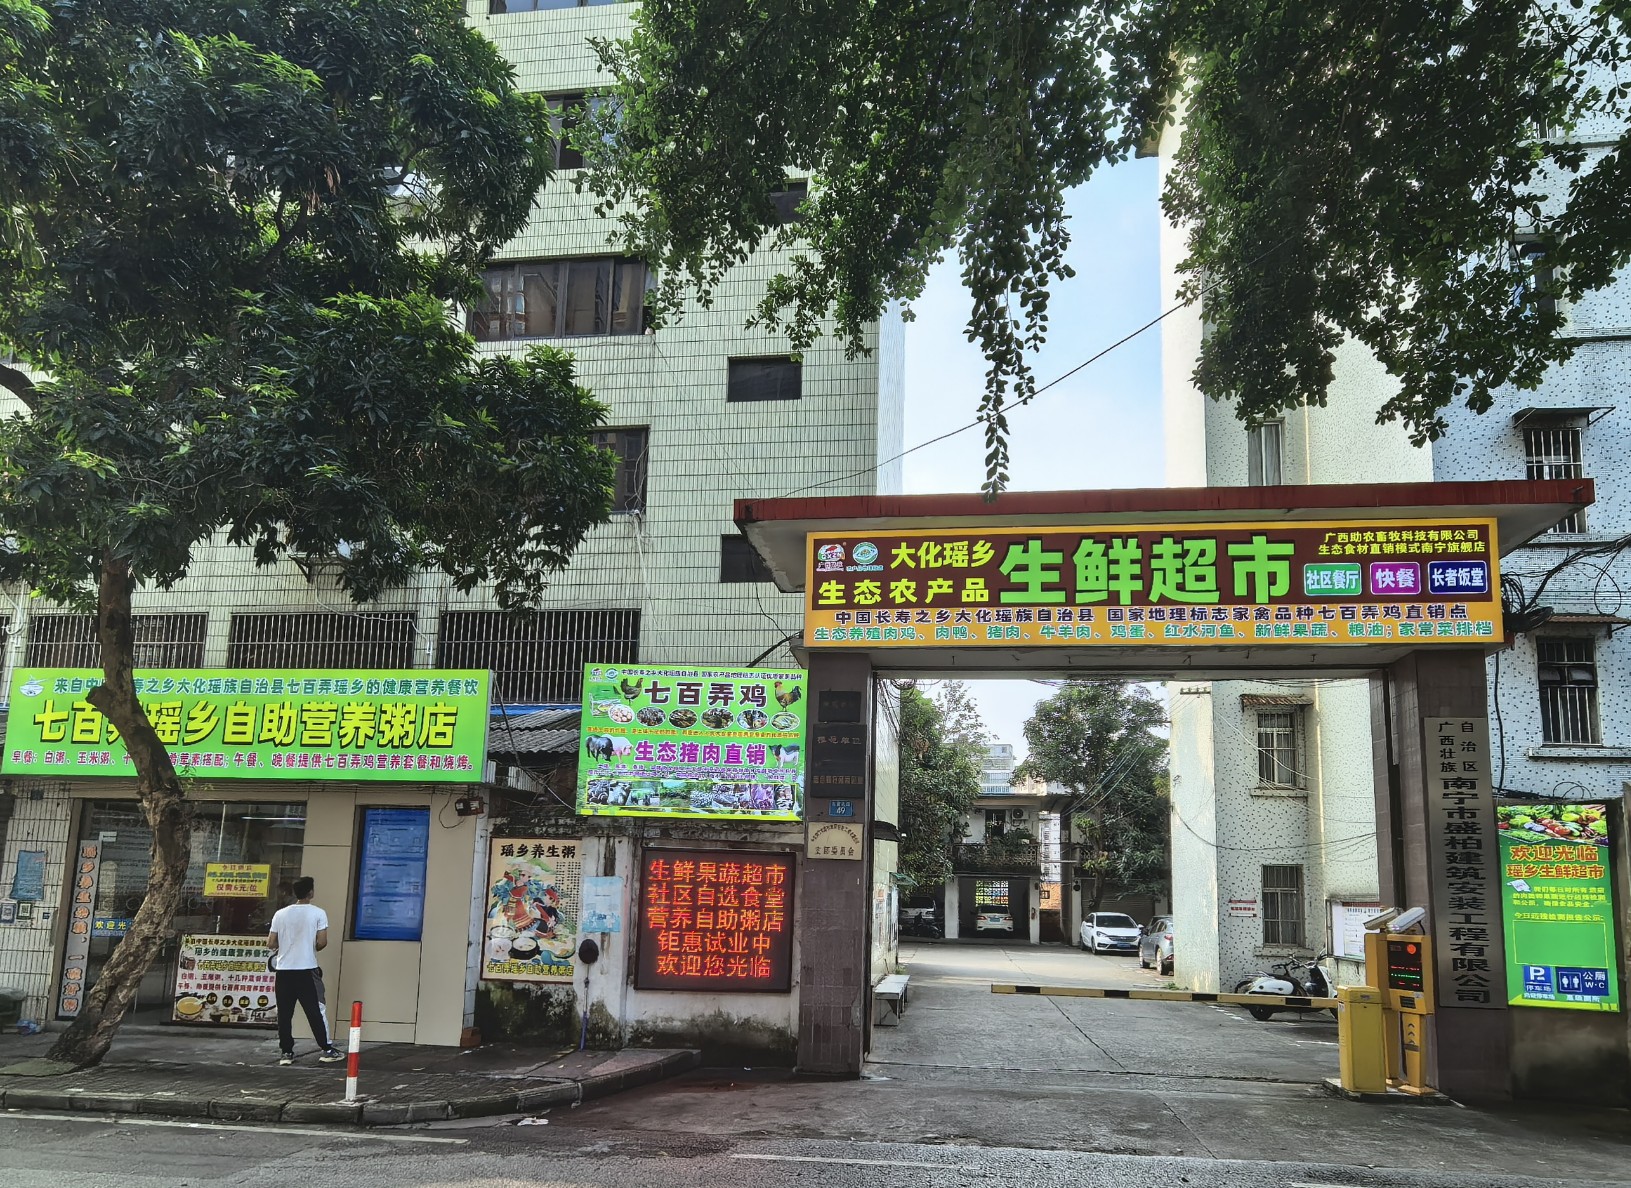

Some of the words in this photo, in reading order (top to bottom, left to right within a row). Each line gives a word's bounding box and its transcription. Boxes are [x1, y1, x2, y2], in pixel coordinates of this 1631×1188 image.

[1324, 529, 1479, 543] 广西助农畜牧科技有限公司
[891, 540, 996, 570] 大化瑶乡
[1318, 542, 1486, 556] 生态食材直销模式南宁旗舰店
[999, 535, 1295, 606] 生鲜超市
[1305, 568, 1361, 590] 社区餐厅
[1375, 567, 1416, 590] 快餐
[1432, 566, 1485, 588] 长者饭堂
[818, 577, 990, 606] 生态农产品
[835, 608, 1095, 625] 中国长寿之乡大化瑶族自治县
[1107, 604, 1469, 623] 国家地理标志家禽品种七百弄鸡直销点
[53, 676, 479, 696] 来自中寿之乡大化瑶族自治县七百弄瑶乡的健康营养餐饮
[643, 680, 768, 708] 七百弄鸡
[32, 698, 459, 748] 七百瑶乡自助营养粥店
[635, 740, 767, 766] 生态猪肉直销
[1438, 721, 1457, 773] 广西壮族
[1461, 721, 1478, 772] 自治区
[500, 843, 576, 859] 瑶乡养生粥
[1509, 845, 1599, 862] 欢迎光临
[648, 859, 786, 886] 生鲜果蔬超市
[1506, 864, 1605, 879] 瑶乡生鲜超市
[647, 884, 785, 908] 社区自选食堂
[95, 920, 131, 930] 欢迎光
[647, 906, 784, 932] 营养自助粥店
[657, 930, 771, 954] 钜惠试业中
[656, 954, 771, 978] 欢迎您光临
[1530, 967, 1541, 980] P
[1582, 971, 1606, 981] 公厕
